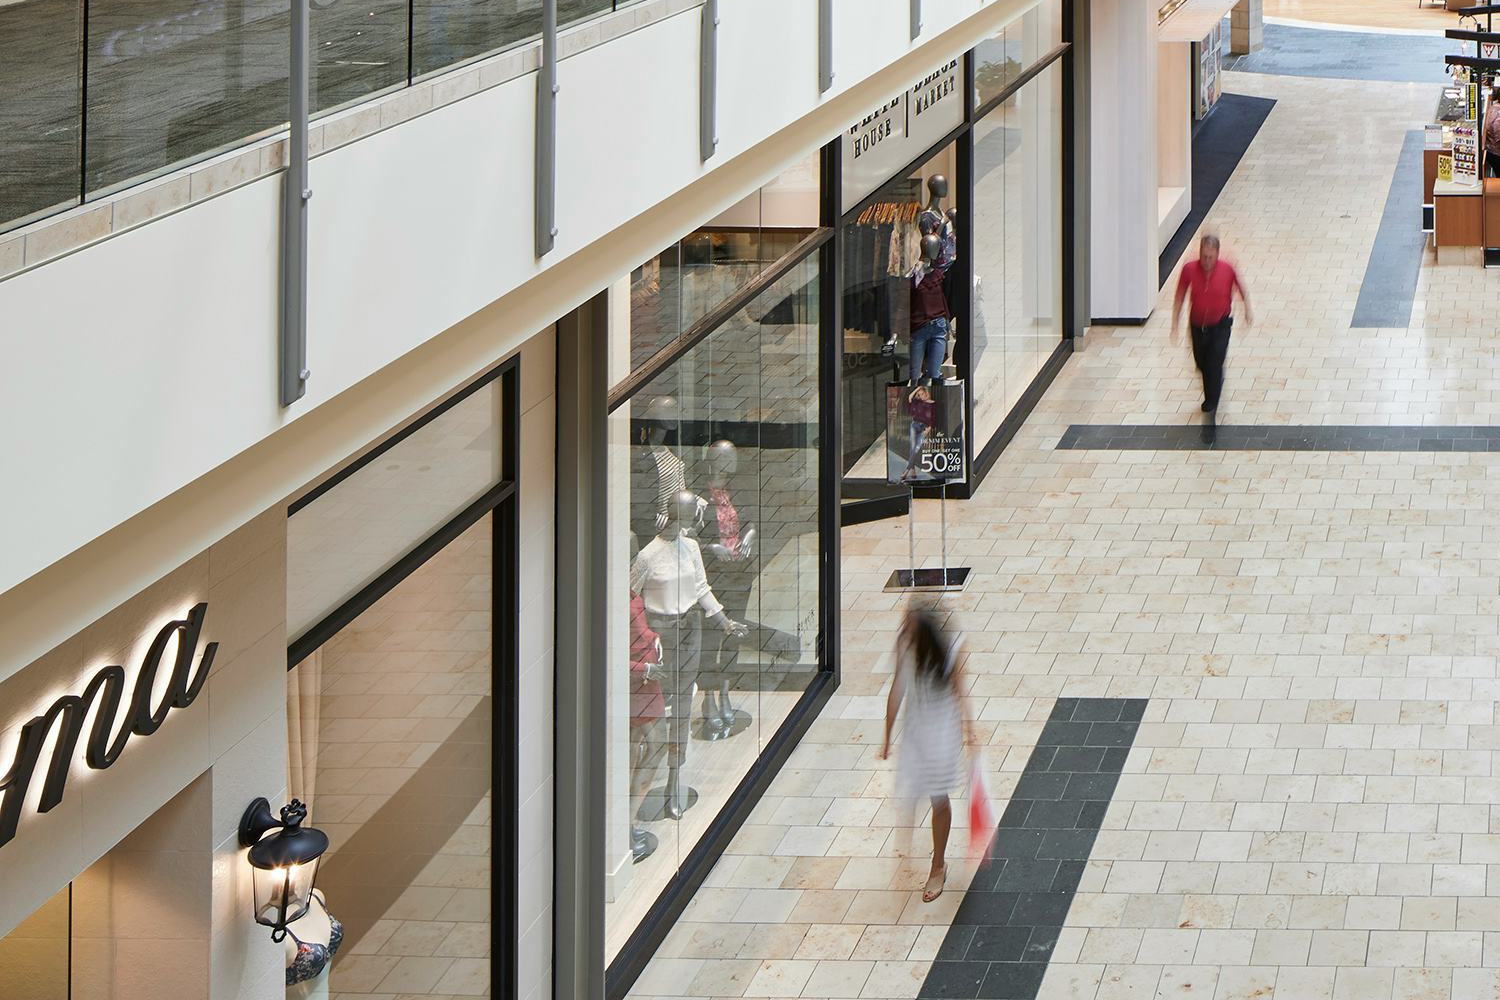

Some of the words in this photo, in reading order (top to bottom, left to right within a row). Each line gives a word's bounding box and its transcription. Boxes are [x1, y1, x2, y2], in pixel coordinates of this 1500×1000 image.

[915, 76, 955, 116] MARKET
[854, 119, 891, 159] HOUSE
[921, 453, 961, 473] 50%
